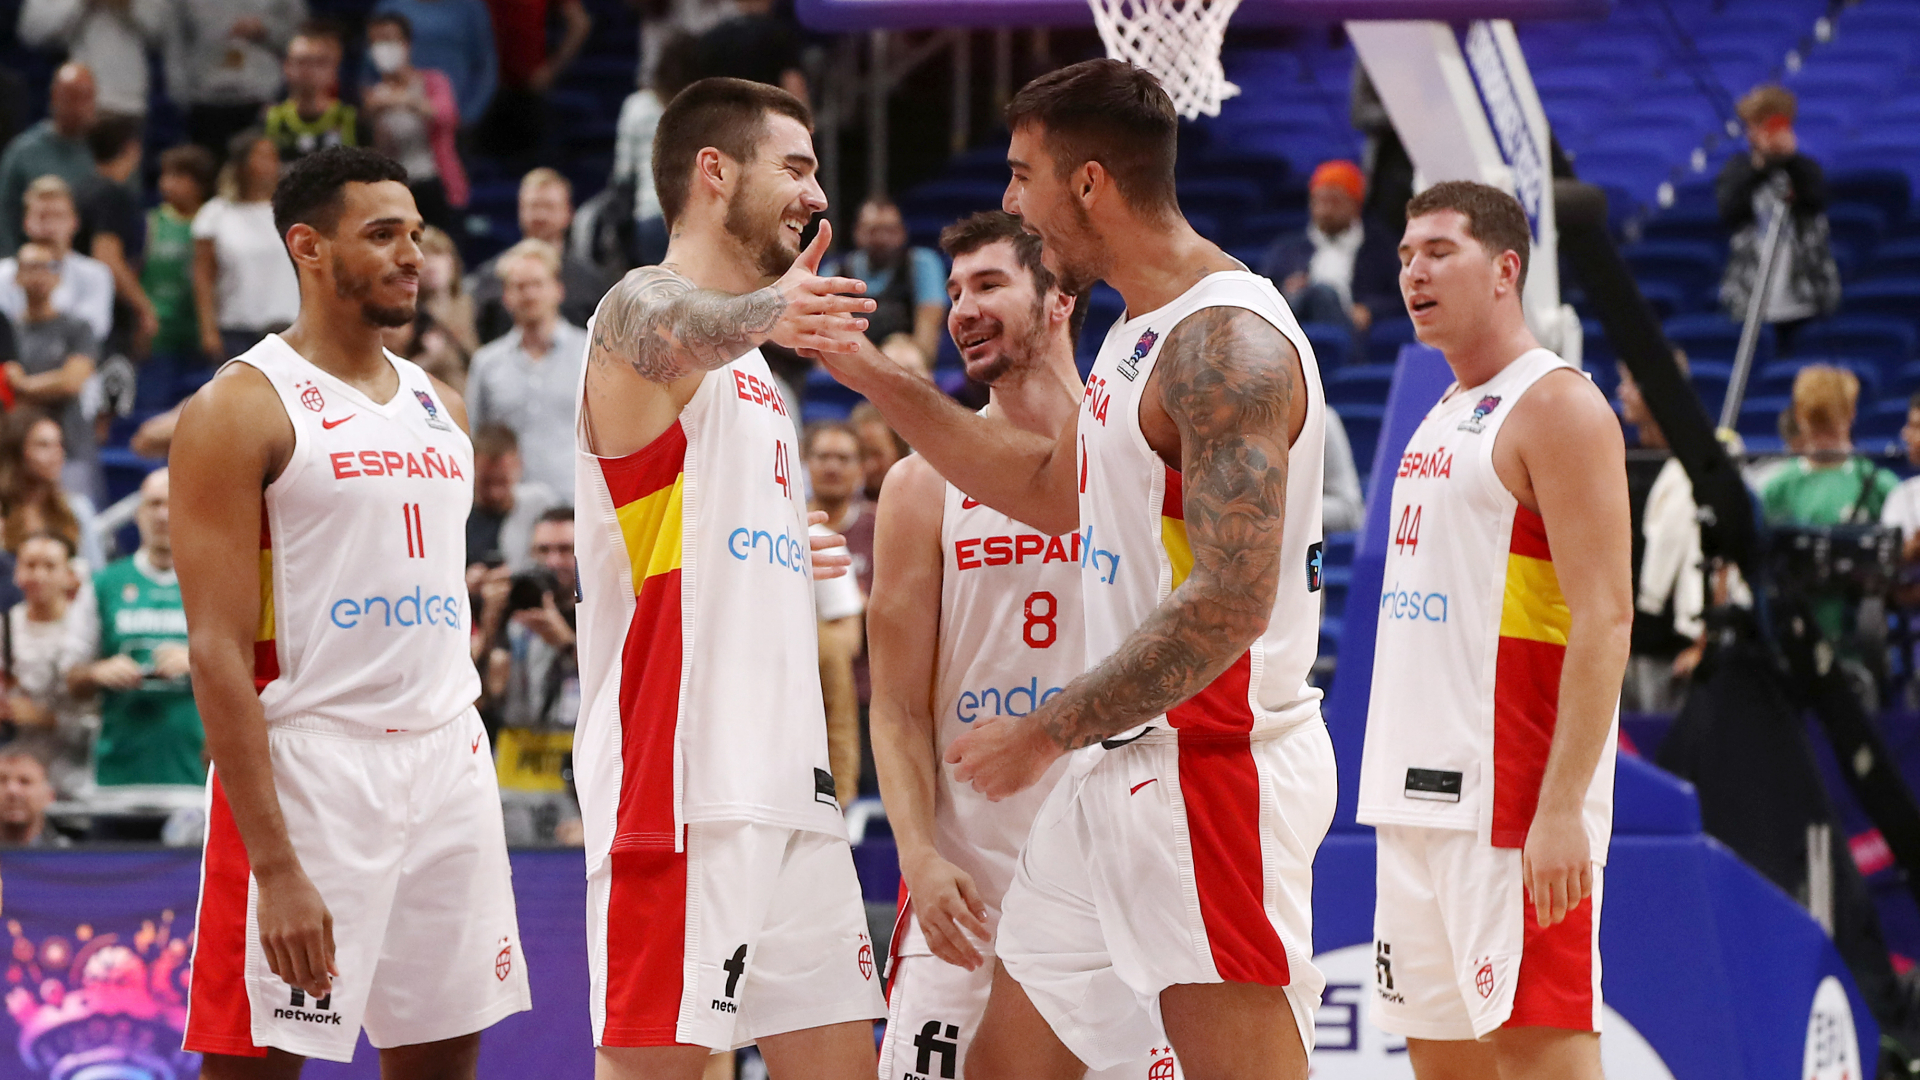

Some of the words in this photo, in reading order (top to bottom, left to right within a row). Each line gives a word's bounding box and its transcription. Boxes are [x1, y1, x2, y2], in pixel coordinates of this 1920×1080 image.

[330, 447, 465, 480] ESPAÑA
[774, 439, 792, 500] 41
[1396, 446, 1453, 479] SPAÑA
[403, 503, 425, 558] 11
[1396, 505, 1422, 556] 44
[330, 585, 461, 630] endes
[1023, 591, 1057, 648] 8
[274, 1008, 342, 1025] network
[913, 1020, 960, 1080] fi
